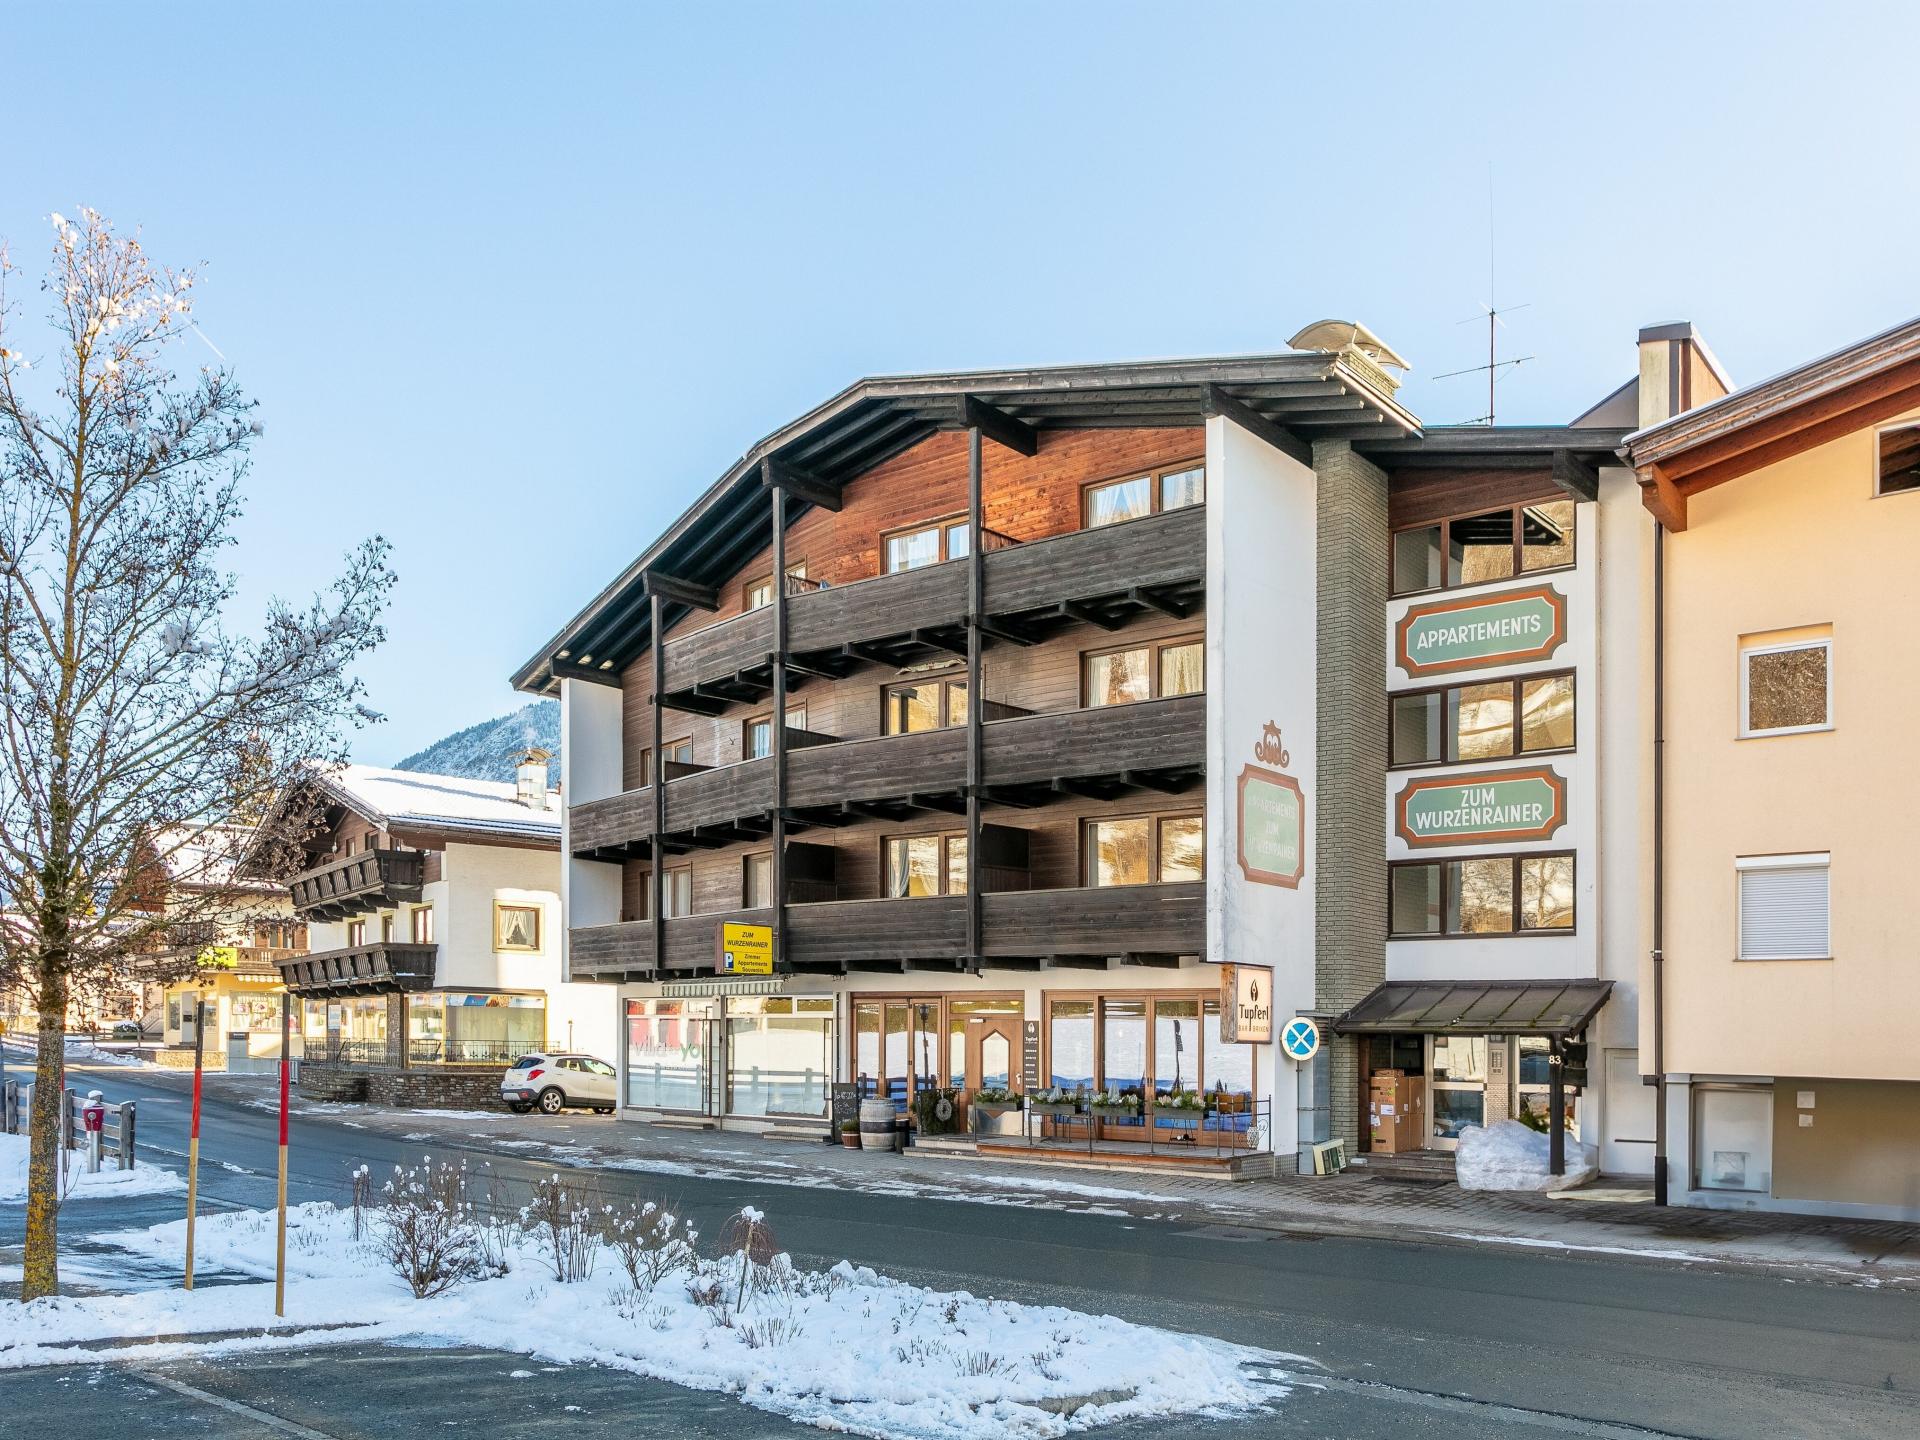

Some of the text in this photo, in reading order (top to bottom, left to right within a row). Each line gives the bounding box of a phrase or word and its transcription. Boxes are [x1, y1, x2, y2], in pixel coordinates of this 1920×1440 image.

[1416, 614, 1541, 651] APPARTEMENTS
[1247, 796, 1296, 820] AARTEMENTS
[1460, 787, 1495, 808] ZUM
[1415, 803, 1543, 830] WURZENRAINER
[1247, 833, 1296, 860] WZENRAINER
[727, 940, 768, 948] WURZENRAINER
[1239, 1004, 1268, 1031] Tupferl
[1548, 1054, 1562, 1065] 83
